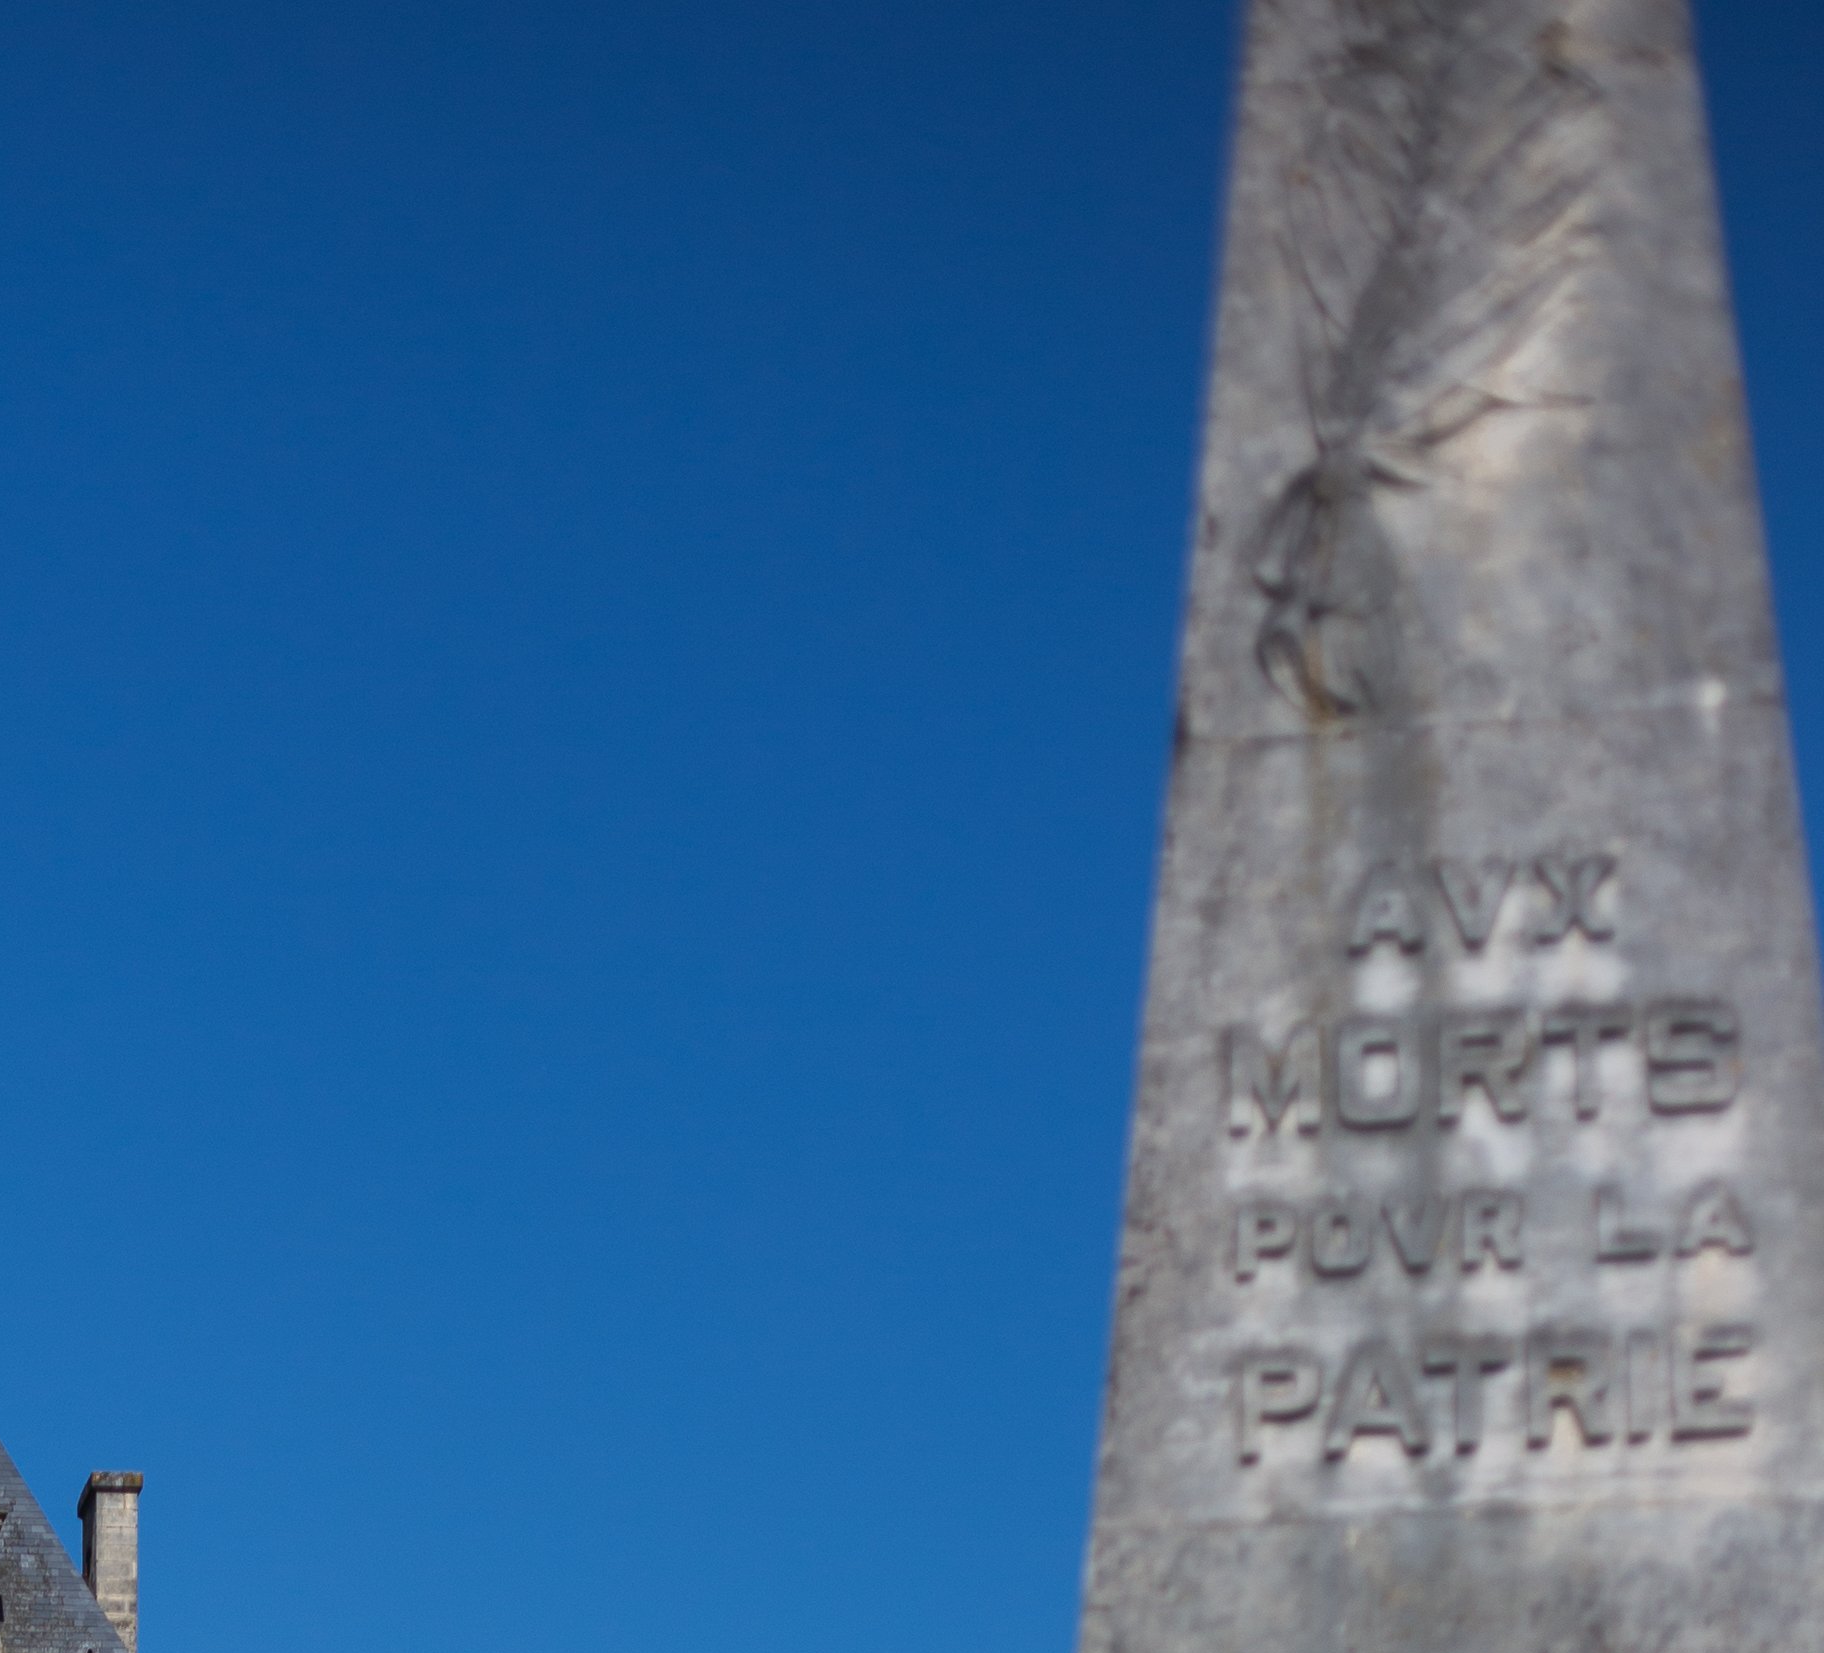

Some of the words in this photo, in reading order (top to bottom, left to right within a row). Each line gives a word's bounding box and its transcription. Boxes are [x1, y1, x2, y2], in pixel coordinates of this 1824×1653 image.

[1345, 852, 1618, 957] AVX
[1219, 997, 1744, 1141] MORTS
[1231, 1187, 1526, 1284] POVR
[1591, 1179, 1758, 1266] LA
[1234, 1322, 1760, 1468] PATRIE
